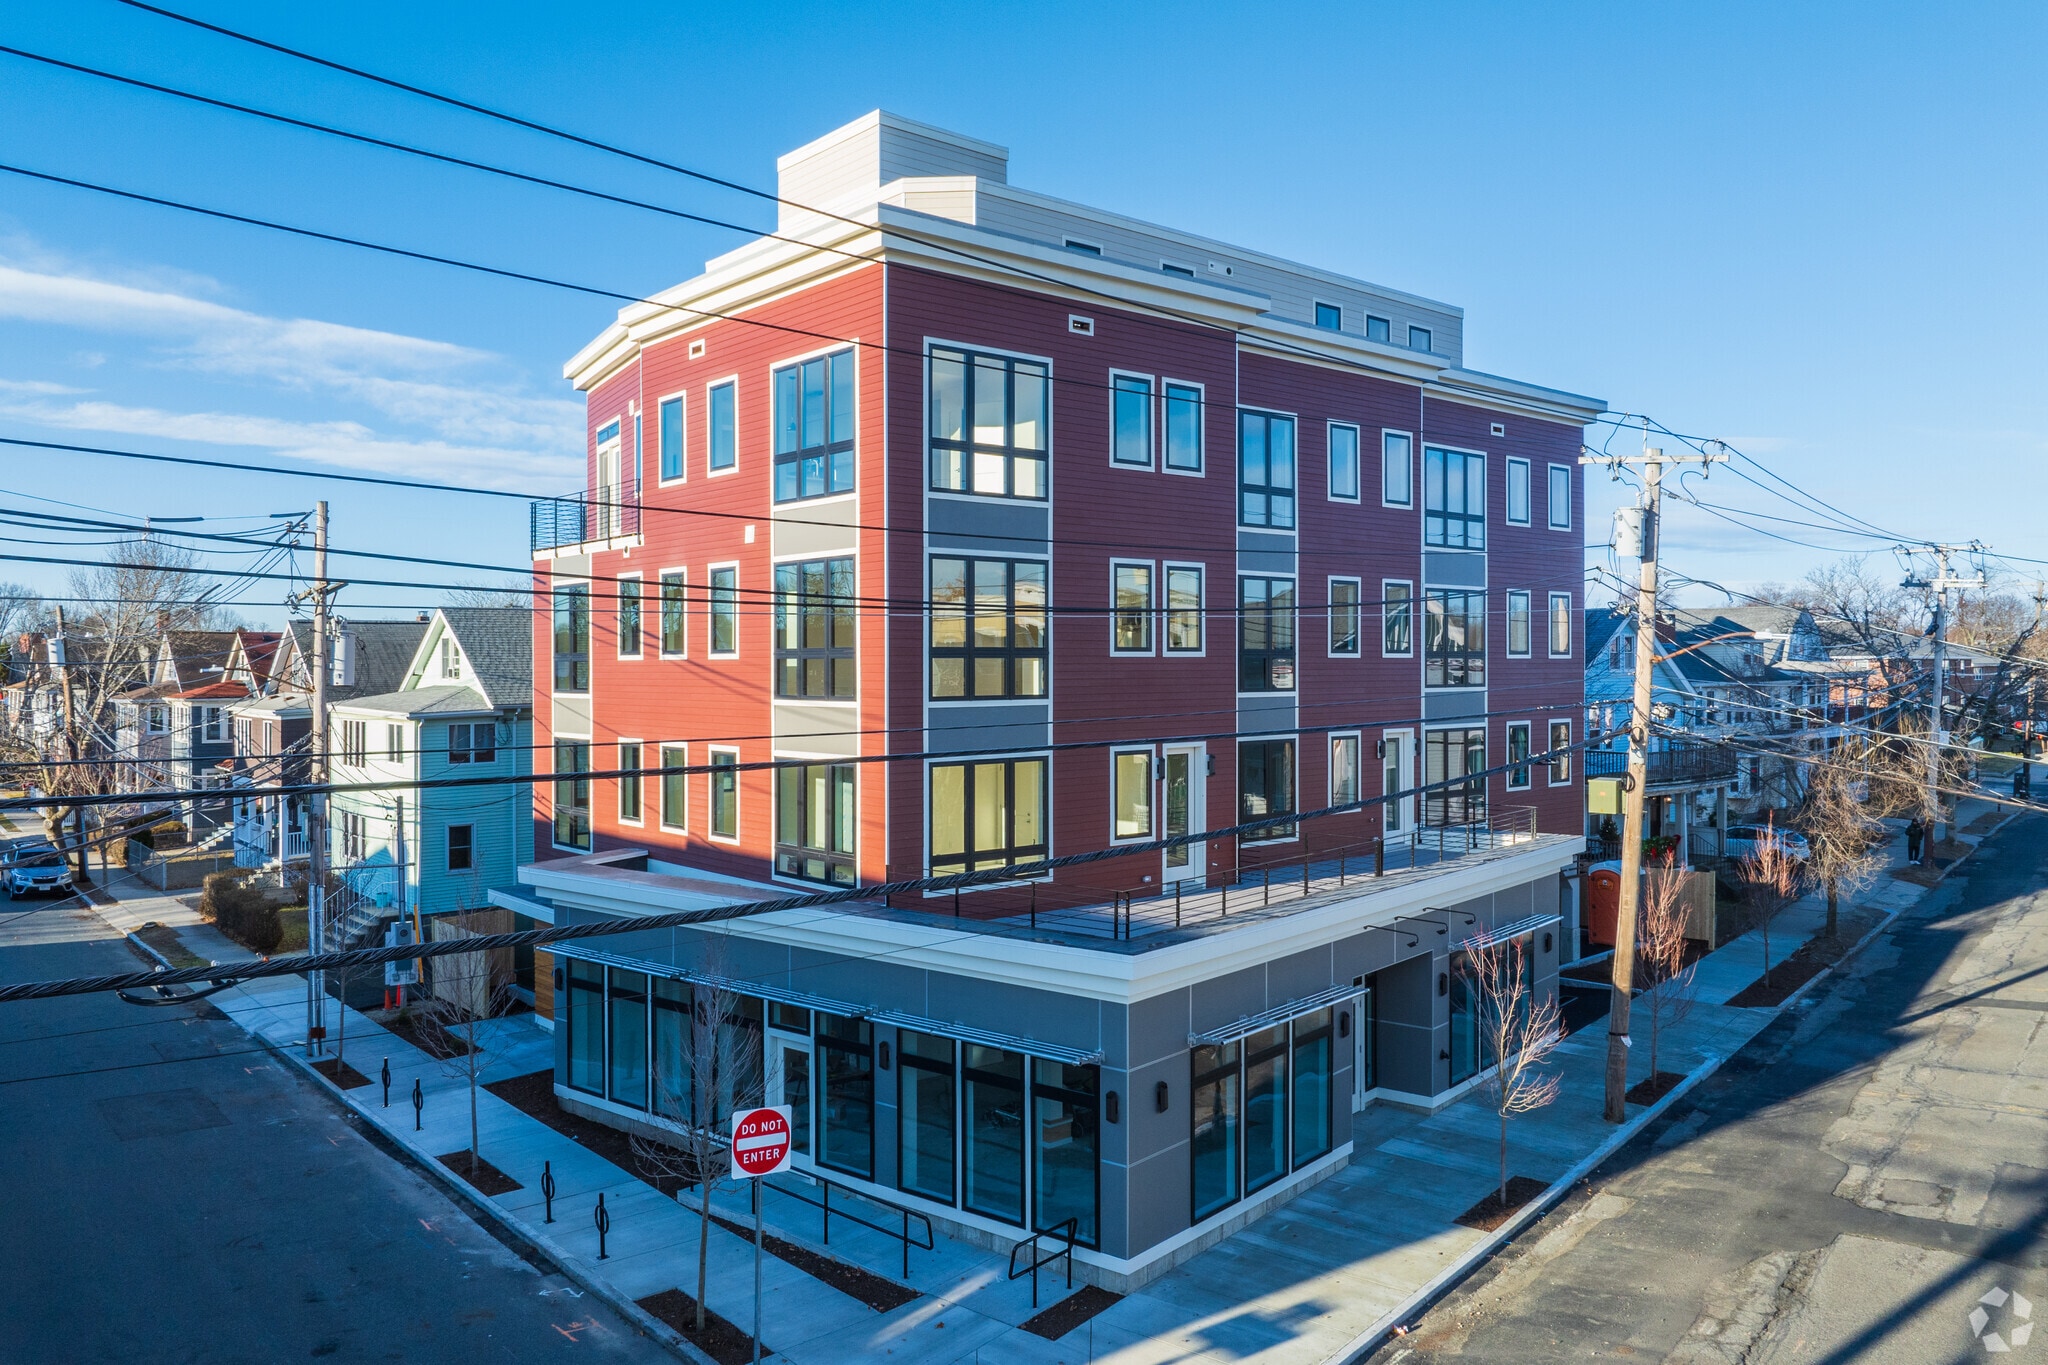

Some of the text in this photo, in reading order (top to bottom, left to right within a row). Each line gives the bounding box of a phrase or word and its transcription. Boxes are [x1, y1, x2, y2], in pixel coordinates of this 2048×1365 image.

[742, 1119, 782, 1135] DO NOT
[743, 1148, 780, 1164] ENTER
